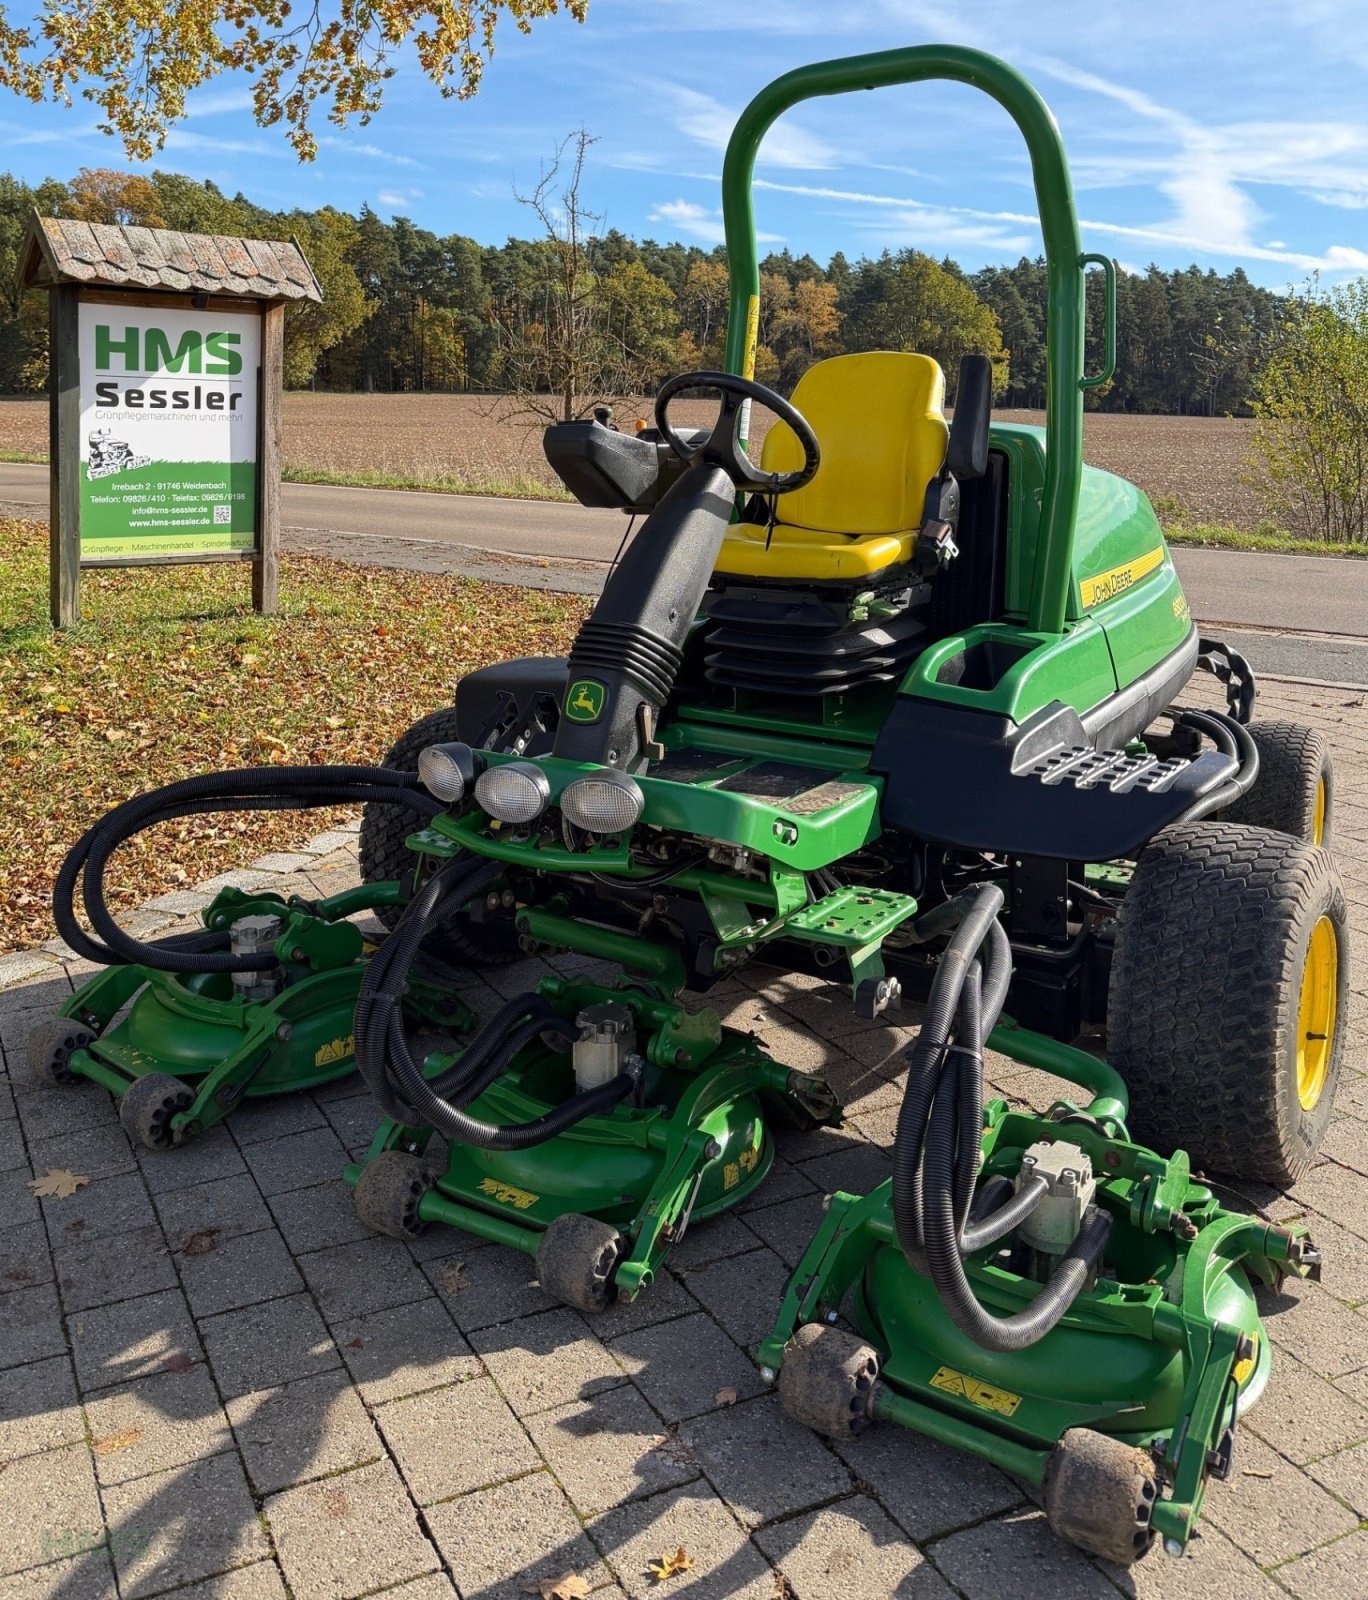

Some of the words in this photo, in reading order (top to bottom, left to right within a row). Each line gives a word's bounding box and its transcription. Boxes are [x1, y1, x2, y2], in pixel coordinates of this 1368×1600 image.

[95, 324, 243, 375] HMS
[95, 382, 243, 410] Sessler
[95, 410, 197, 421] Grünpflegemaschinen
[199, 411, 216, 421] und
[111, 482, 144, 491] Irrebach
[157, 482, 180, 490] 91746
[182, 482, 227, 490] Weidenbach
[90, 495, 121, 503] Telefon:
[172, 493, 200, 502] Telefax:
[132, 506, 208, 515] info@hms-sessler.de
[129, 518, 210, 527] www.hms-sessler.de
[82, 544, 124, 555] Grünpflege
[131, 541, 194, 551] Maschinenhandel
[201, 538, 252, 549] Spindelwartung
